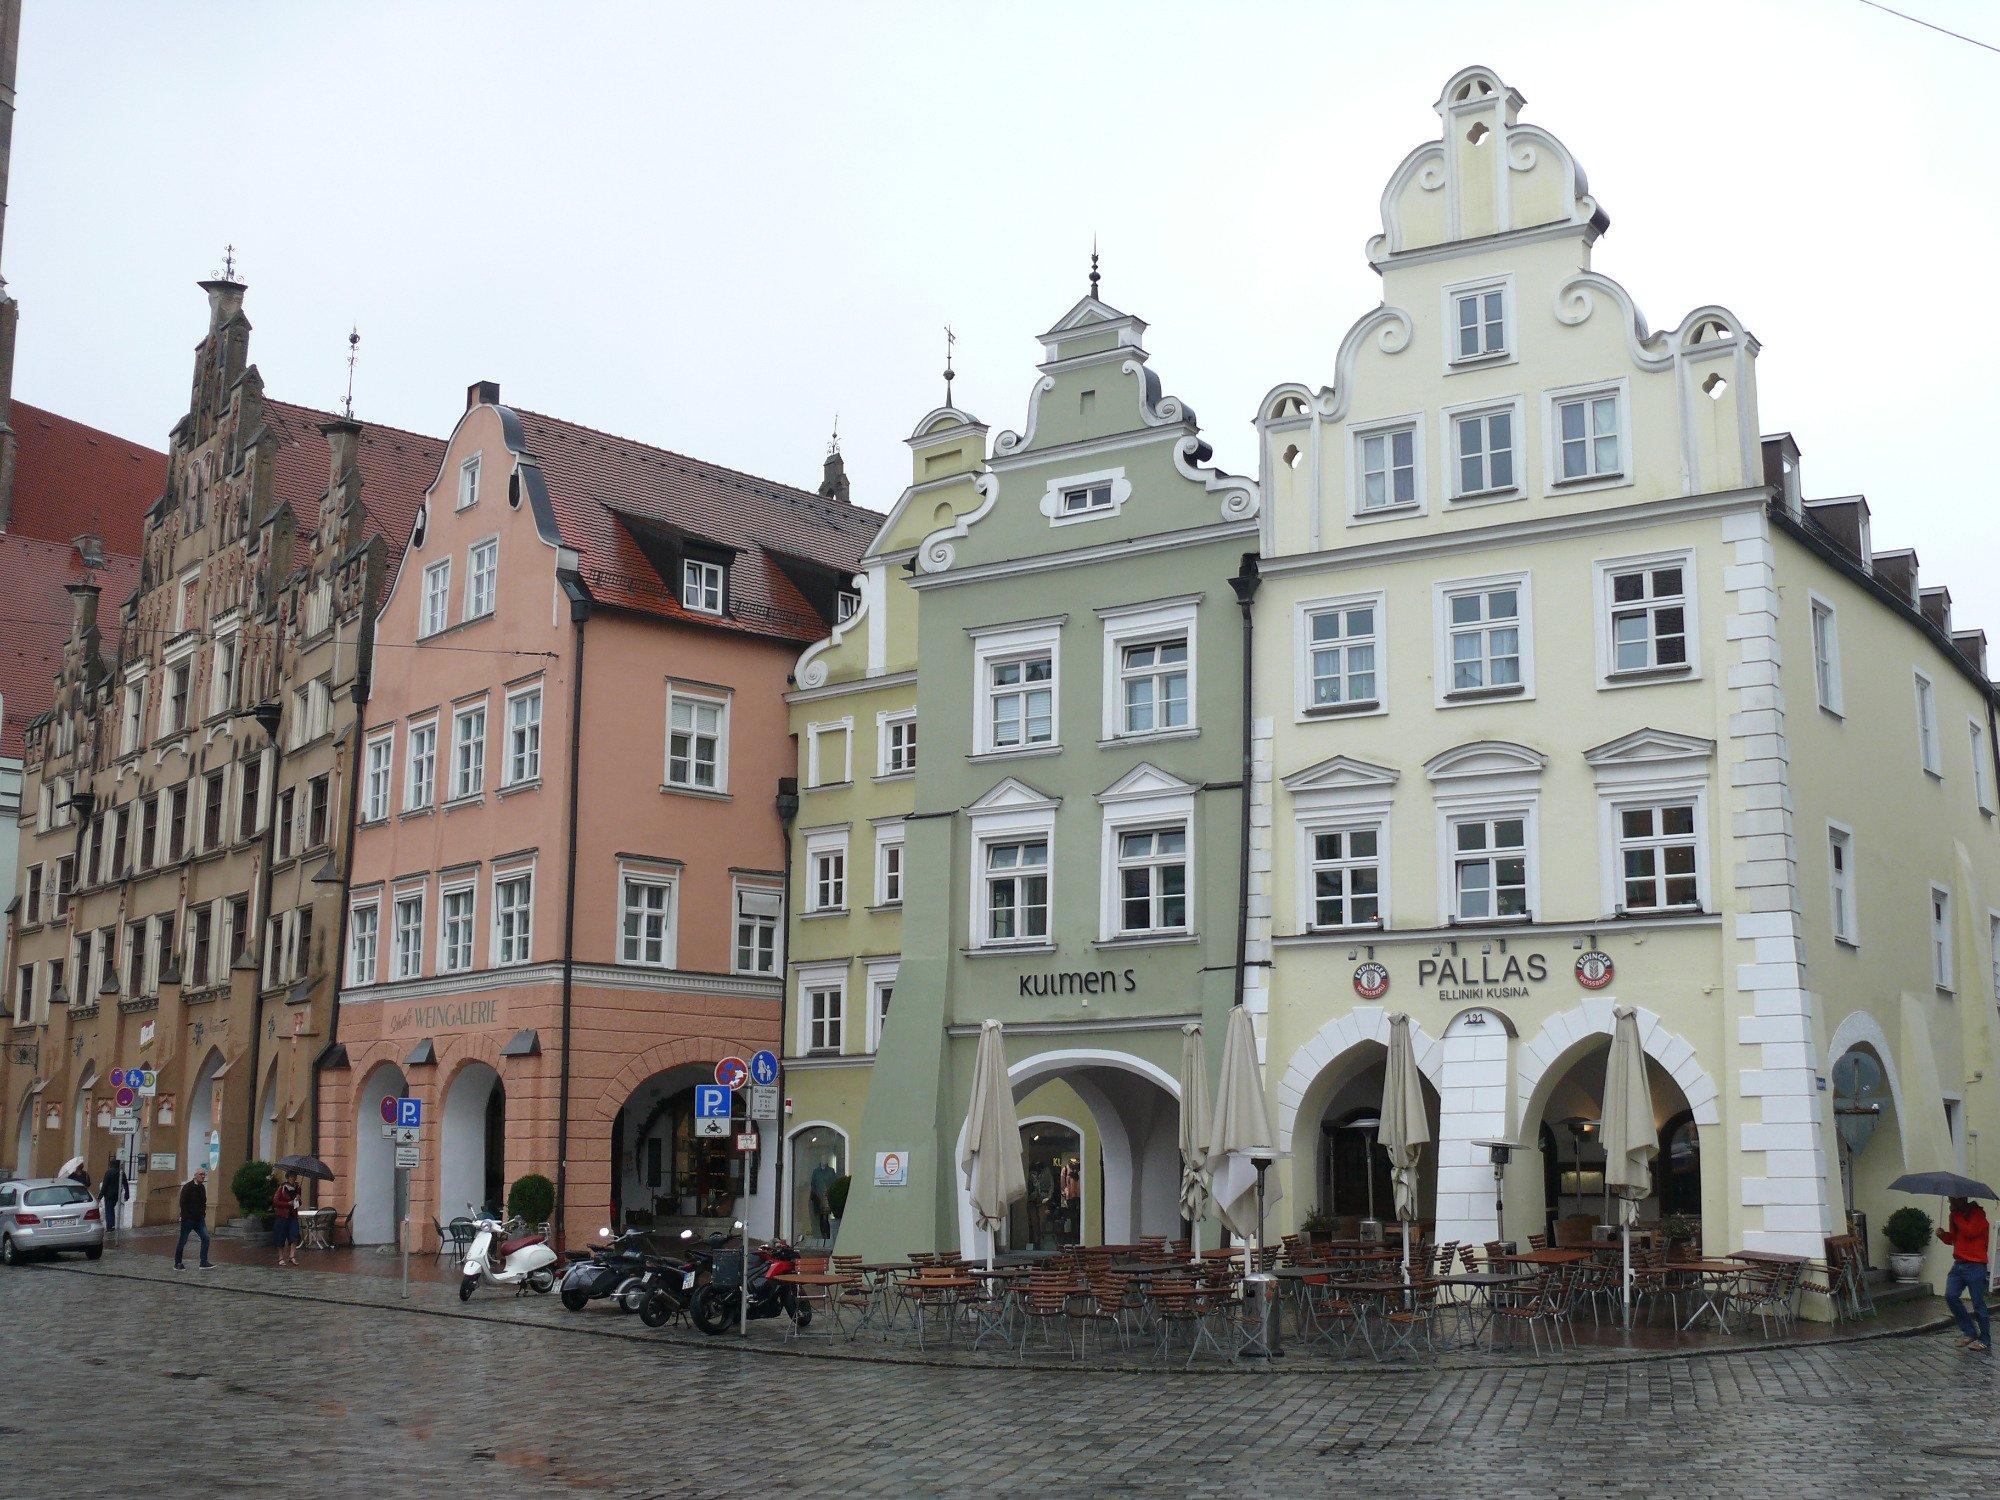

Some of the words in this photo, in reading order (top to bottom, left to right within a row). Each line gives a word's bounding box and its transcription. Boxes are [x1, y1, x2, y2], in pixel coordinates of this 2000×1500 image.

[1355, 964, 1386, 979] ERDINGER
[1418, 953, 1547, 986] PALLAS
[1576, 953, 1611, 968] ERDINGER
[1439, 989, 1484, 1001] ELLINIKI
[1486, 986, 1530, 999] KUSINA
[414, 1000, 500, 1029] WEINGALERIE
[402, 1101, 416, 1124] P
[703, 1089, 723, 1116] P
